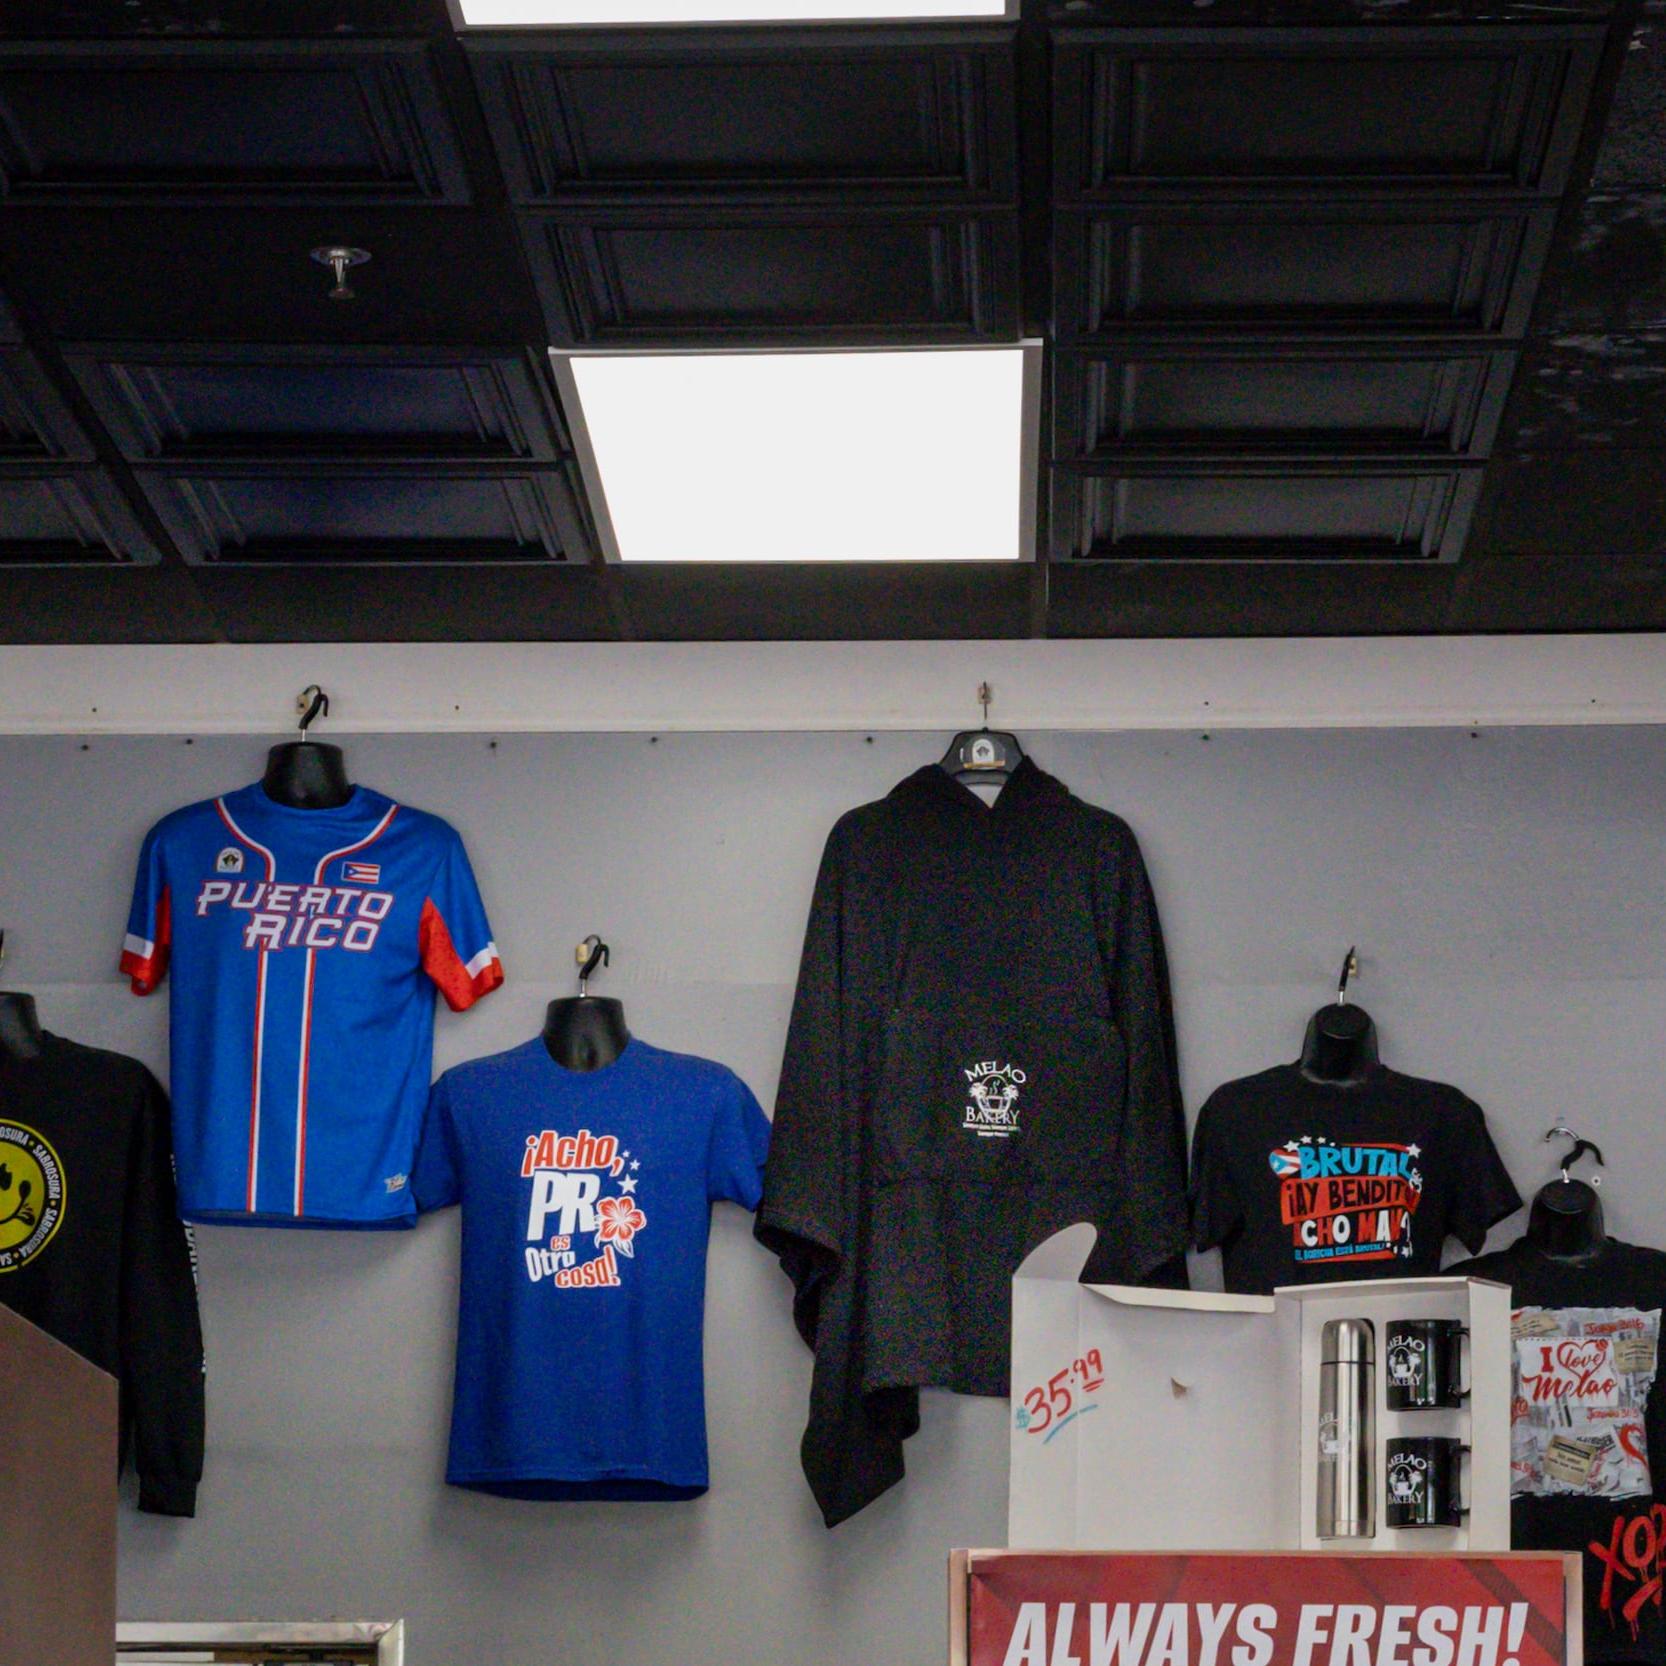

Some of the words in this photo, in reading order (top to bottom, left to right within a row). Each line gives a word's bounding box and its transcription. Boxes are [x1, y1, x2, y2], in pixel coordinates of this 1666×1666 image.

[196, 880, 394, 920] PUERTO
[243, 913, 380, 951] RICO
[964, 1060, 1026, 1083] MELAO
[33, 1144, 61, 1199] SABROSURA
[1298, 1146, 1412, 1180] BRUTAL
[527, 1170, 600, 1241] PR
[551, 1235, 571, 1250] es
[1540, 1346, 1554, 1373] I
